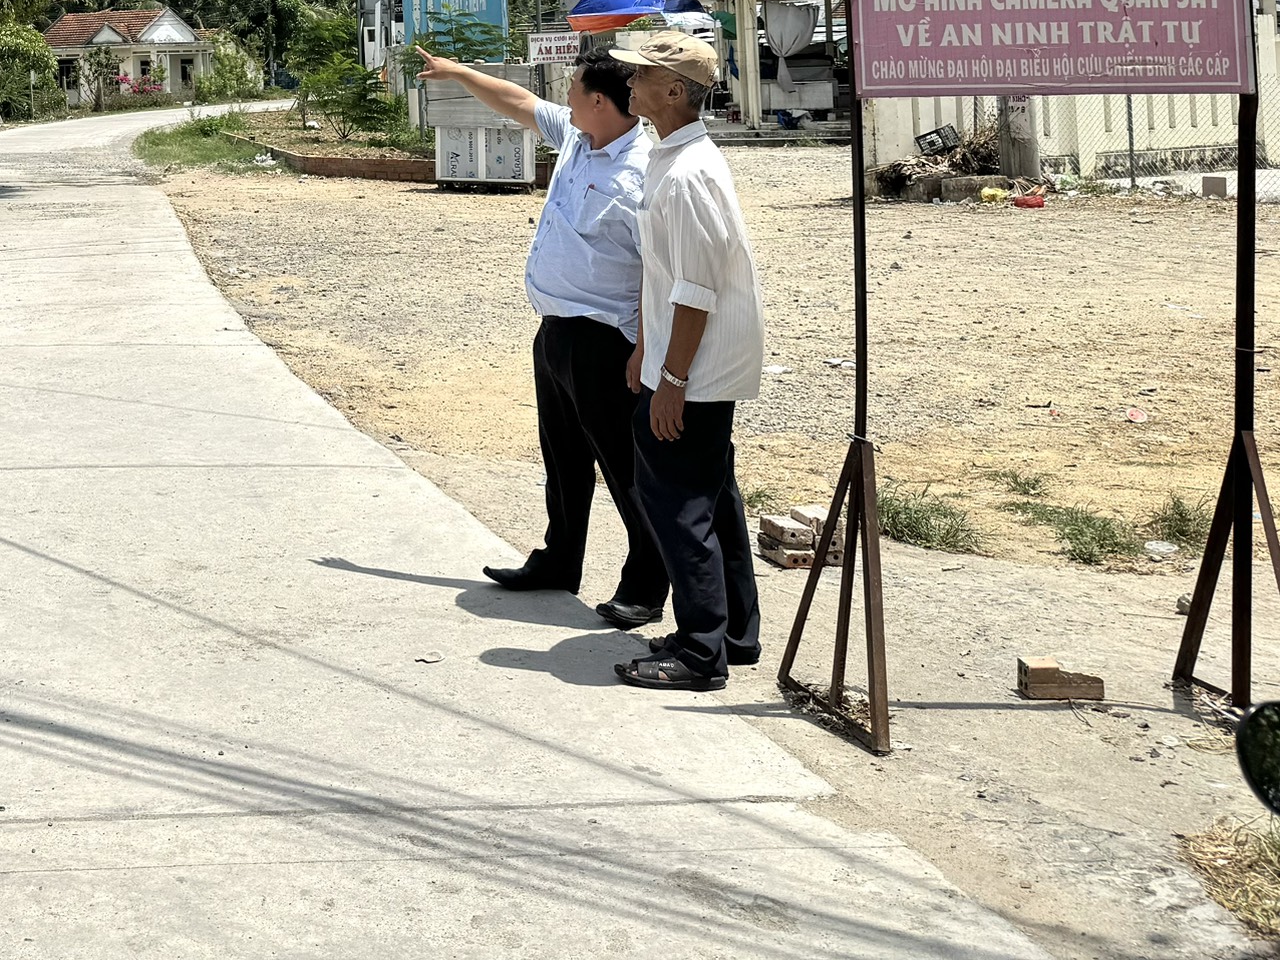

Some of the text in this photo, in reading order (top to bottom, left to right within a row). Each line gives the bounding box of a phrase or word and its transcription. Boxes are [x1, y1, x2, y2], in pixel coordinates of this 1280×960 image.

[896, 15, 1203, 49] VỀ AN NINH TRẬT TỰ
[872, 49, 1230, 82] CHÀO MỪNG ĐẠI HỘI ĐẠI BIỂU HỘI CỰU CHIẾN BINH CÁC CẤP
